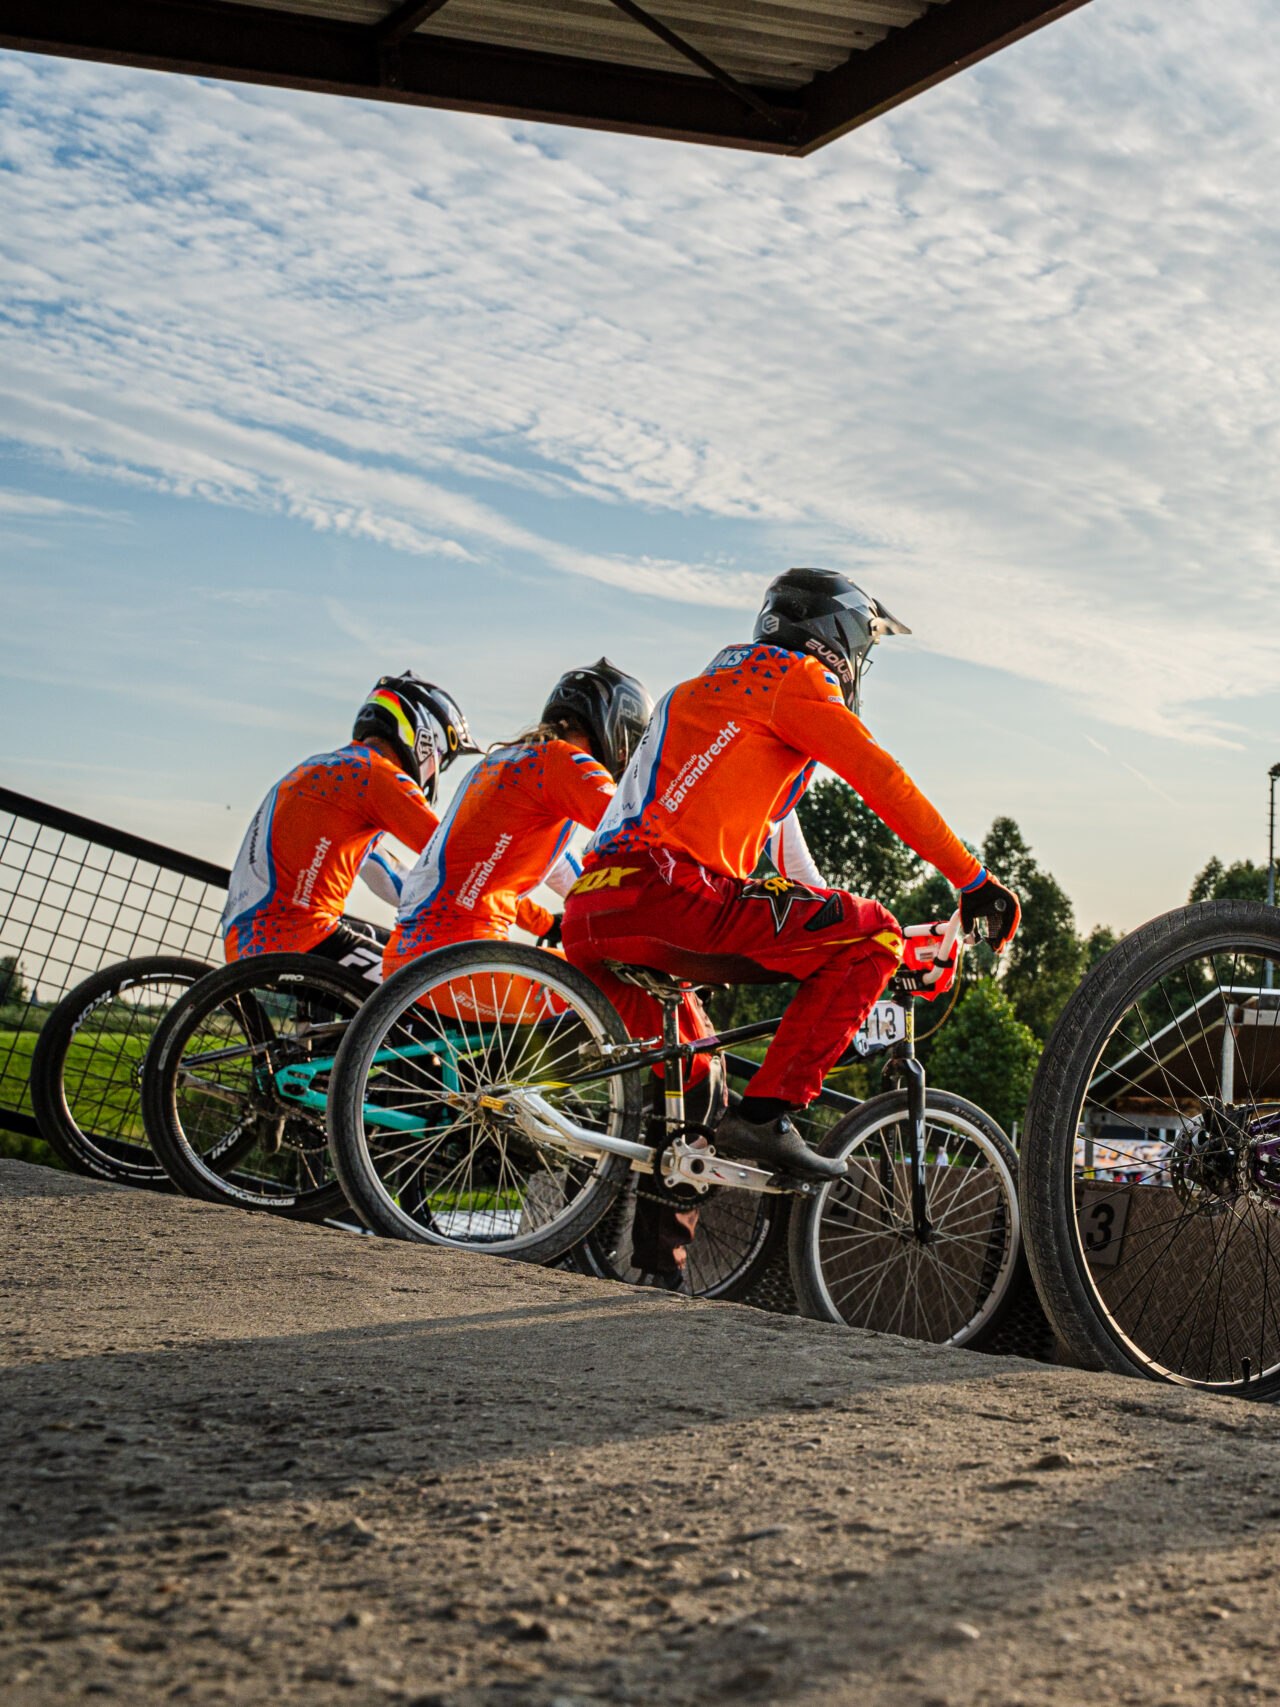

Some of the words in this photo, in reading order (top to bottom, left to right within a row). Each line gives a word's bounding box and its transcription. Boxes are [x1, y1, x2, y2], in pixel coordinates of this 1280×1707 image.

[662, 753, 698, 803] FietsCrossClub
[666, 720, 741, 813] Barendrecht
[463, 832, 513, 910] Barendrecht
[278, 973, 305, 982] PRO
[830, 1175, 854, 1218] 2
[1085, 1203, 1116, 1252] 3
